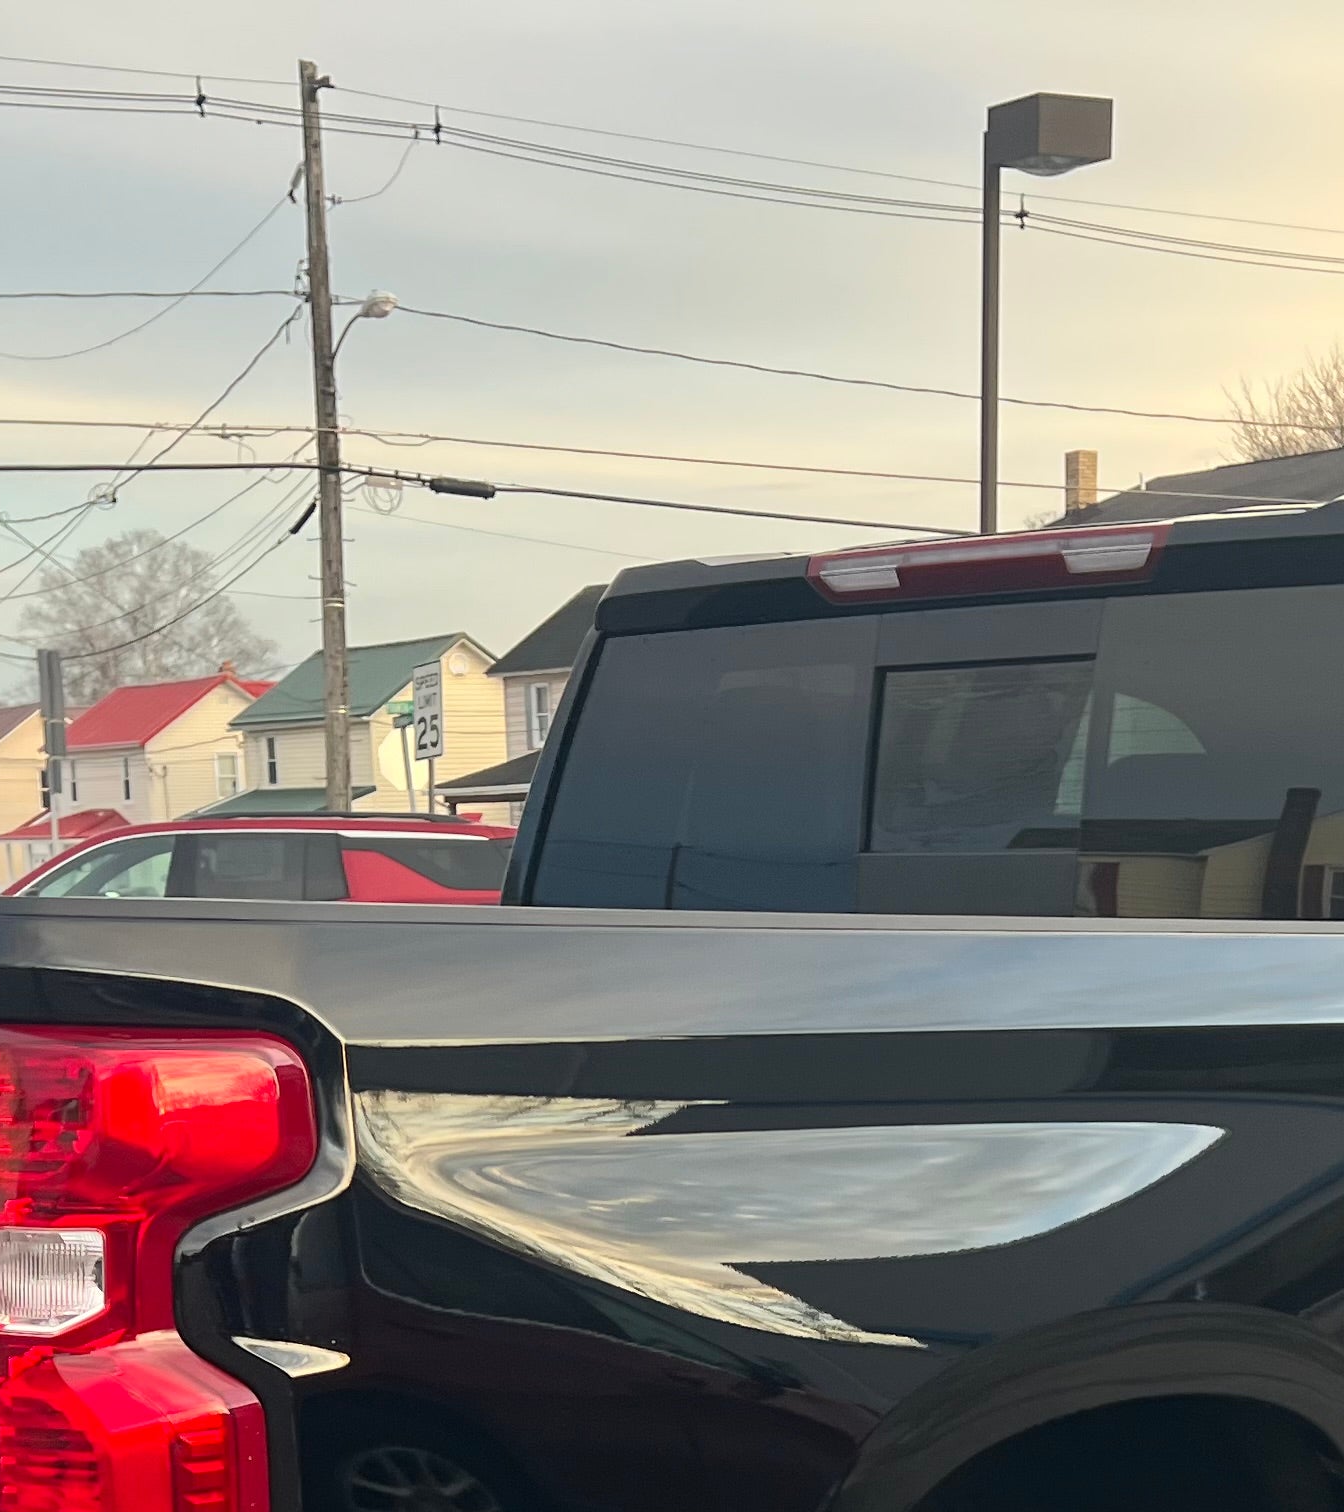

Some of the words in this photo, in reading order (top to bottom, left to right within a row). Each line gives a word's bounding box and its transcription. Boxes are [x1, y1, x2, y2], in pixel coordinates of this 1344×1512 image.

[416, 672, 438, 691] SPEED
[417, 692, 437, 710] LIMIT
[417, 714, 440, 750] 25
